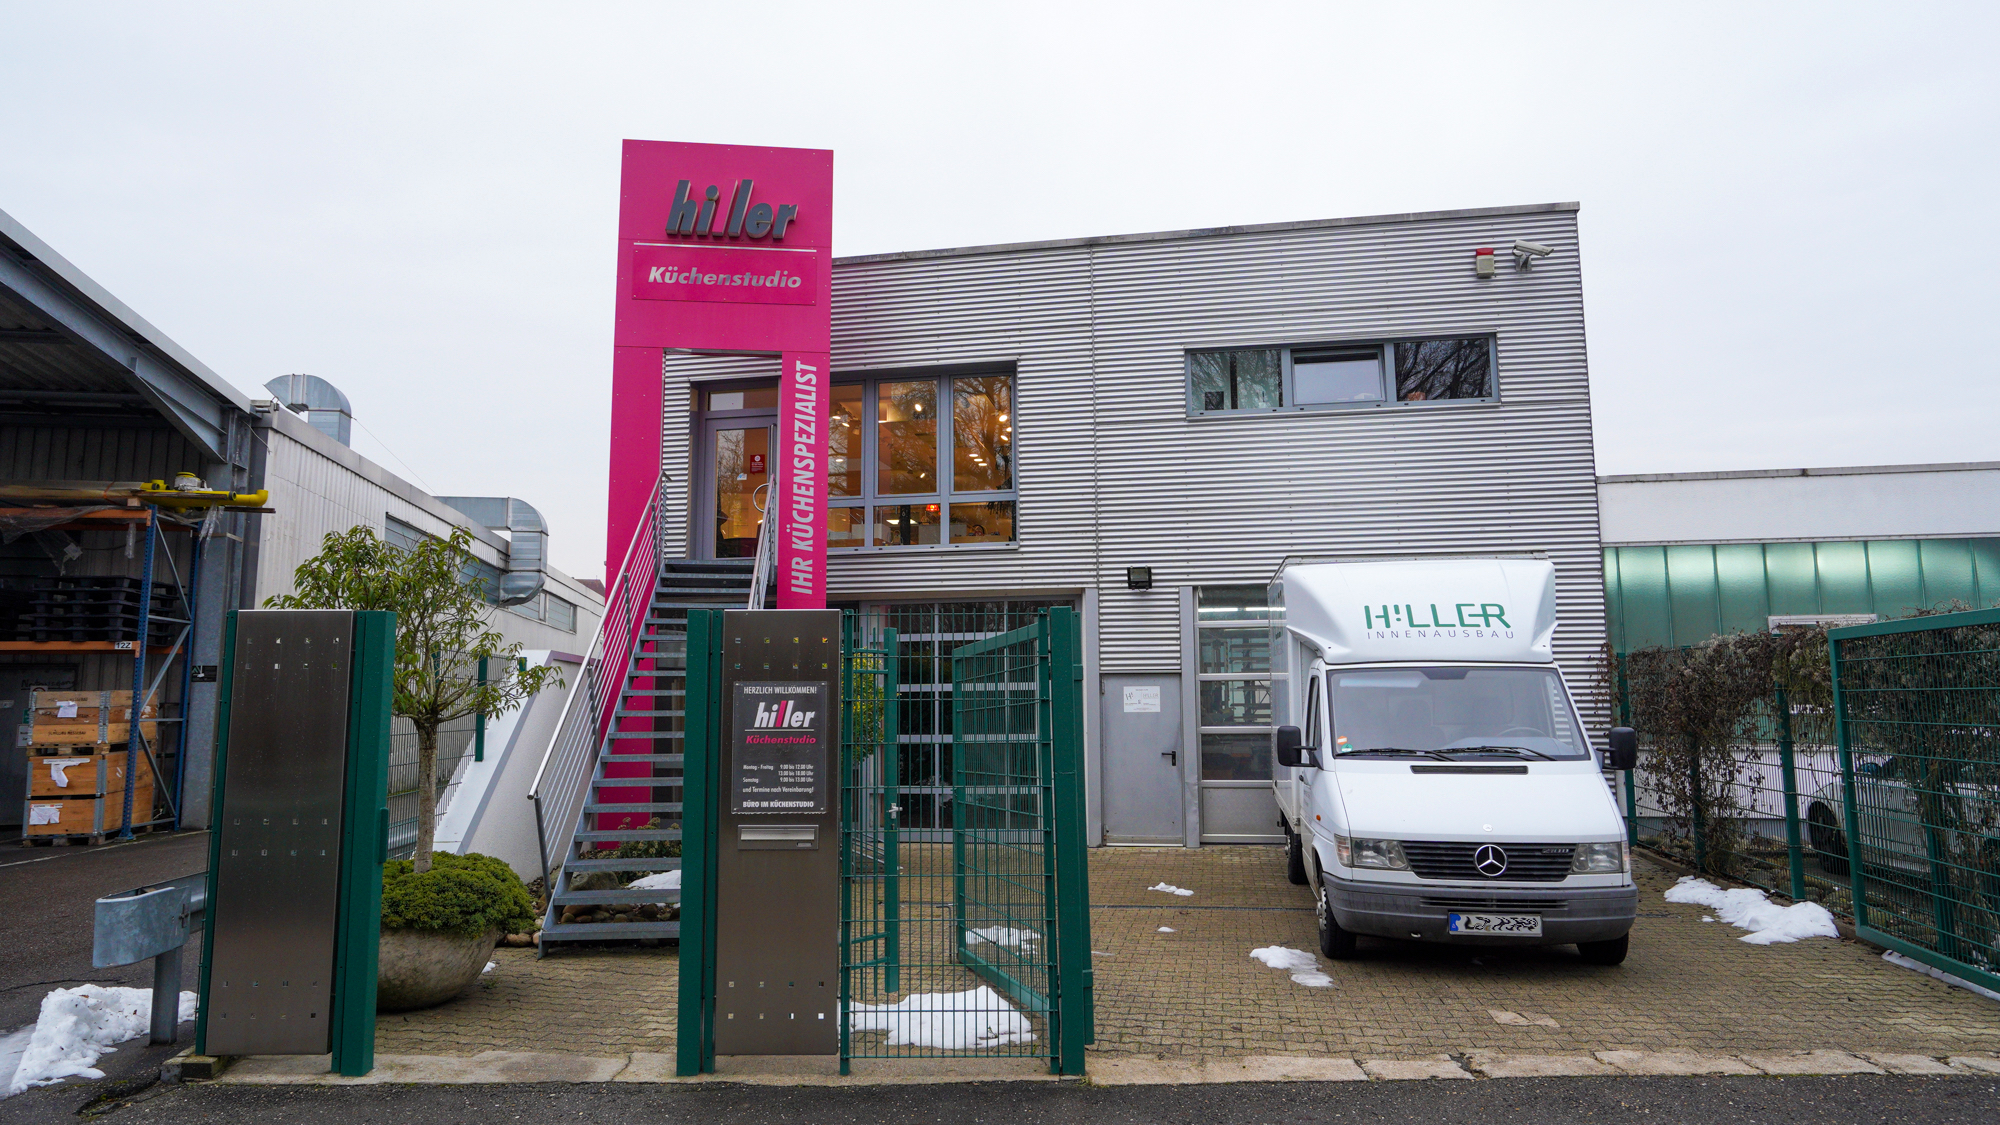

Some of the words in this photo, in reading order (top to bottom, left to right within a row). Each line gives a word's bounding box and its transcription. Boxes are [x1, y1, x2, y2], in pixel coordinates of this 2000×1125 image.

[665, 179, 798, 239] hiller
[648, 266, 802, 288] Küchenstudio
[786, 360, 817, 552] KÜCHENSPEZIALIST
[791, 556, 813, 594] IHR
[1367, 629, 1514, 640] INNENAUSBAU
[743, 686, 773, 694] HERZLICH
[754, 700, 816, 728] hiller
[745, 735, 817, 744] Küchenstudio
[742, 800, 760, 808] BÜRO
[769, 800, 814, 808] KÜCHENSTUDIO
